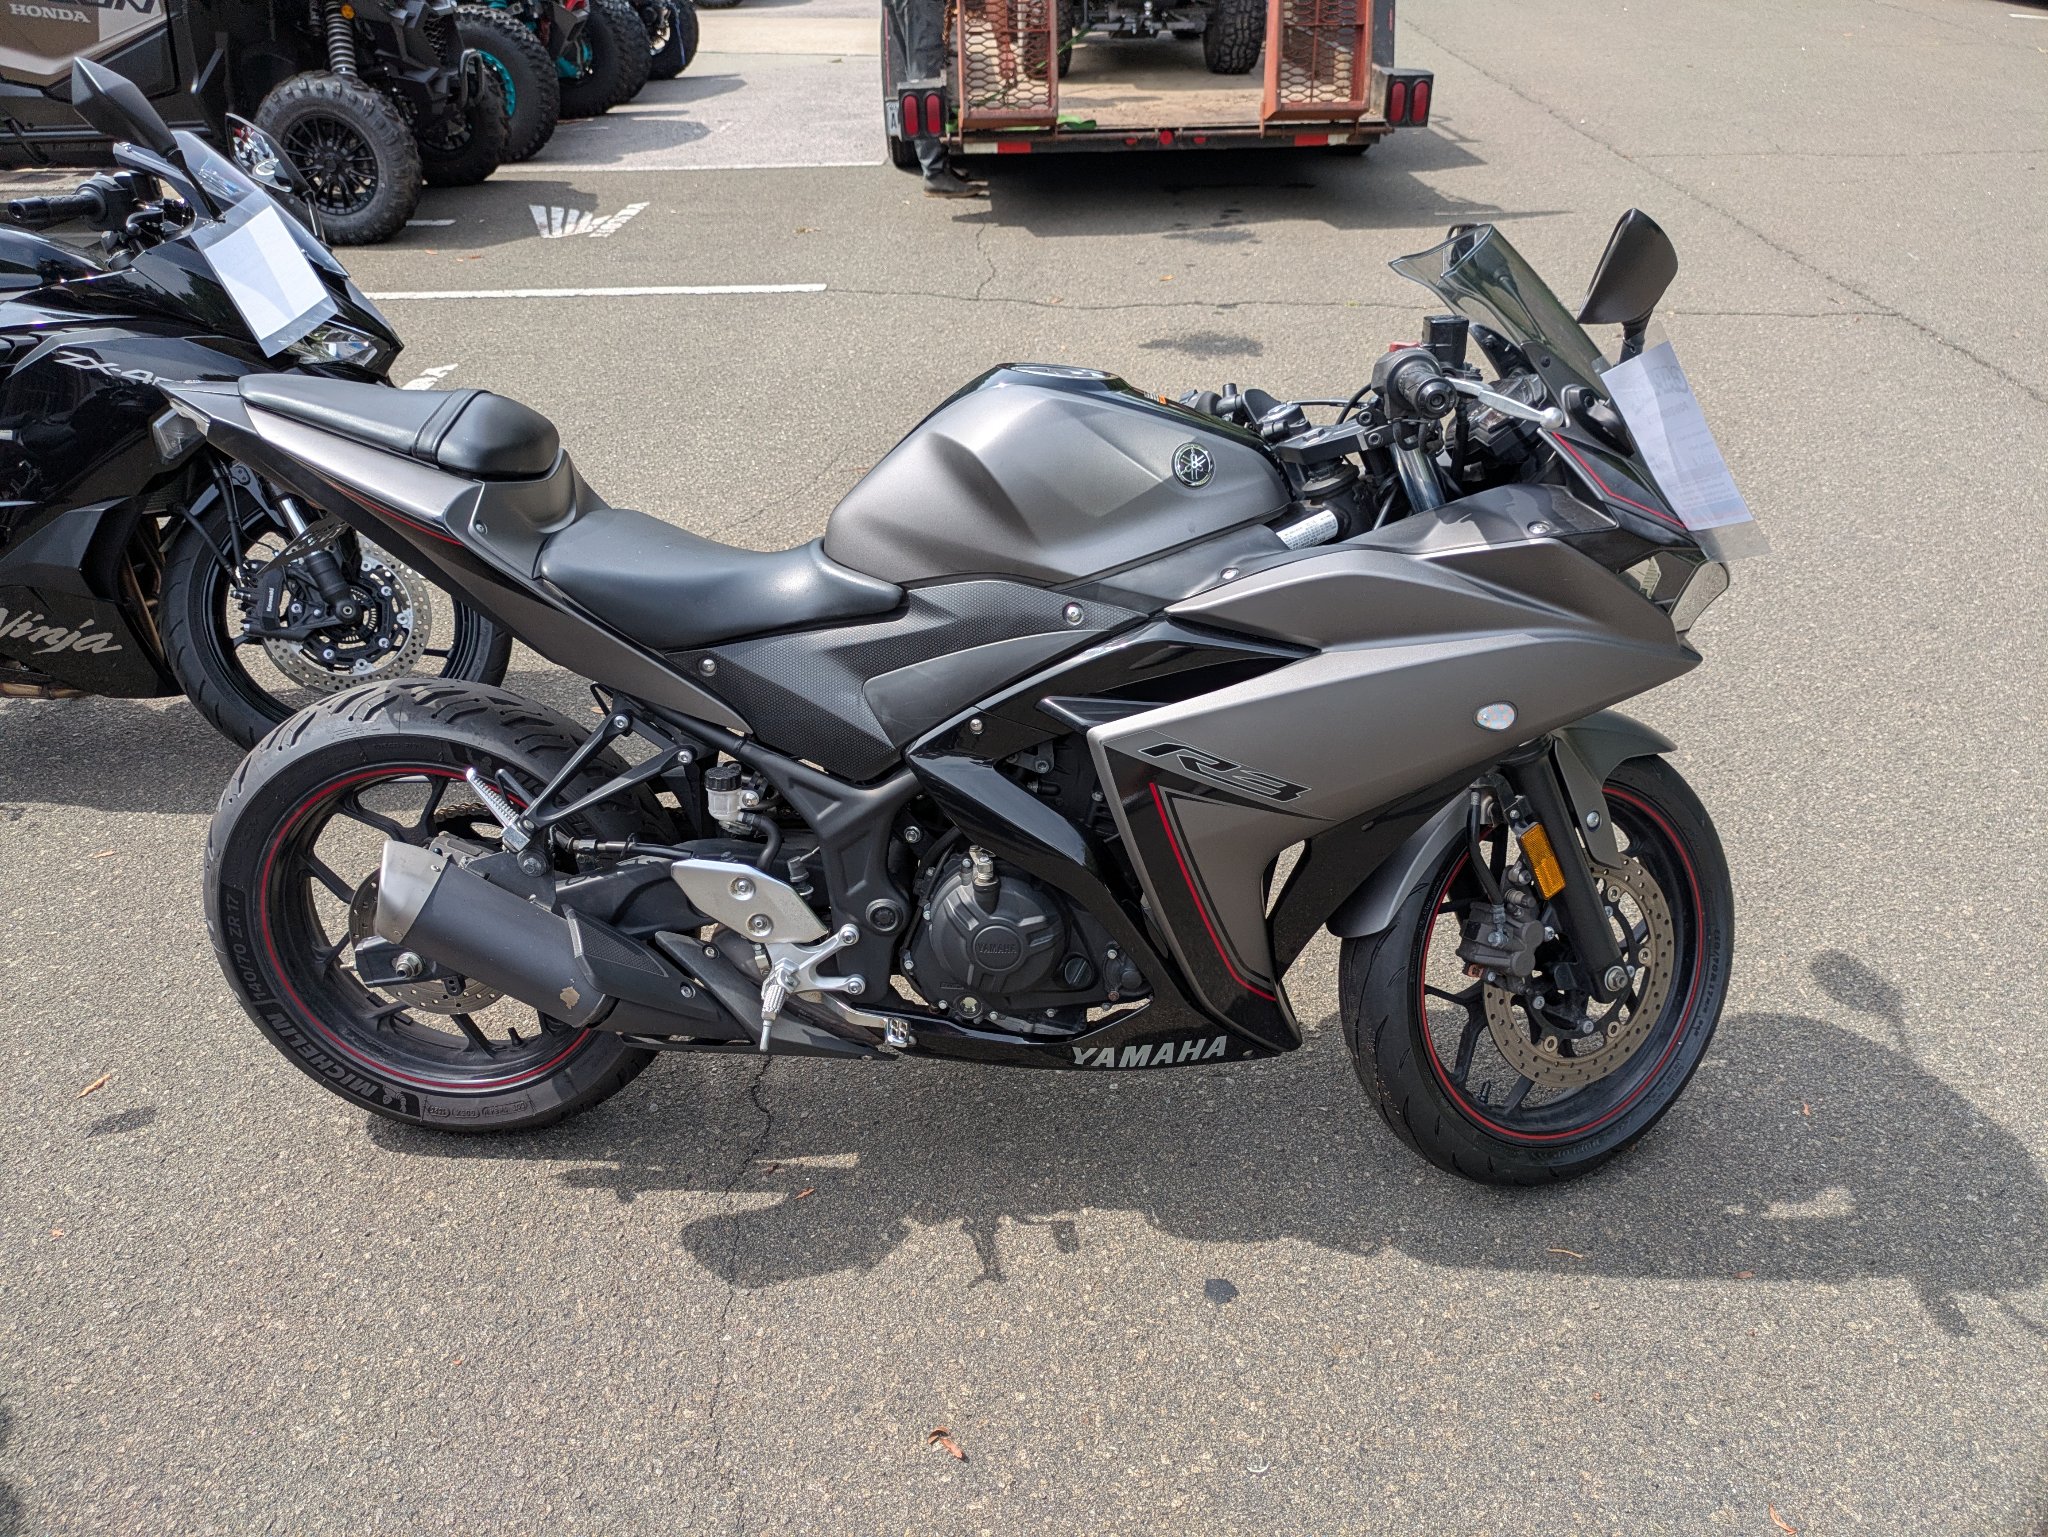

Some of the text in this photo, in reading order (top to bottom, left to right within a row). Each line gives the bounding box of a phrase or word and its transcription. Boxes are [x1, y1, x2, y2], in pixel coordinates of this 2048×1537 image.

[9, 3, 91, 23] HONDA
[225, 893, 267, 999] 140/70 ZR 17
[265, 1011, 380, 1098] MICHELIN
[1072, 1035, 1228, 1068] YAMAHA
